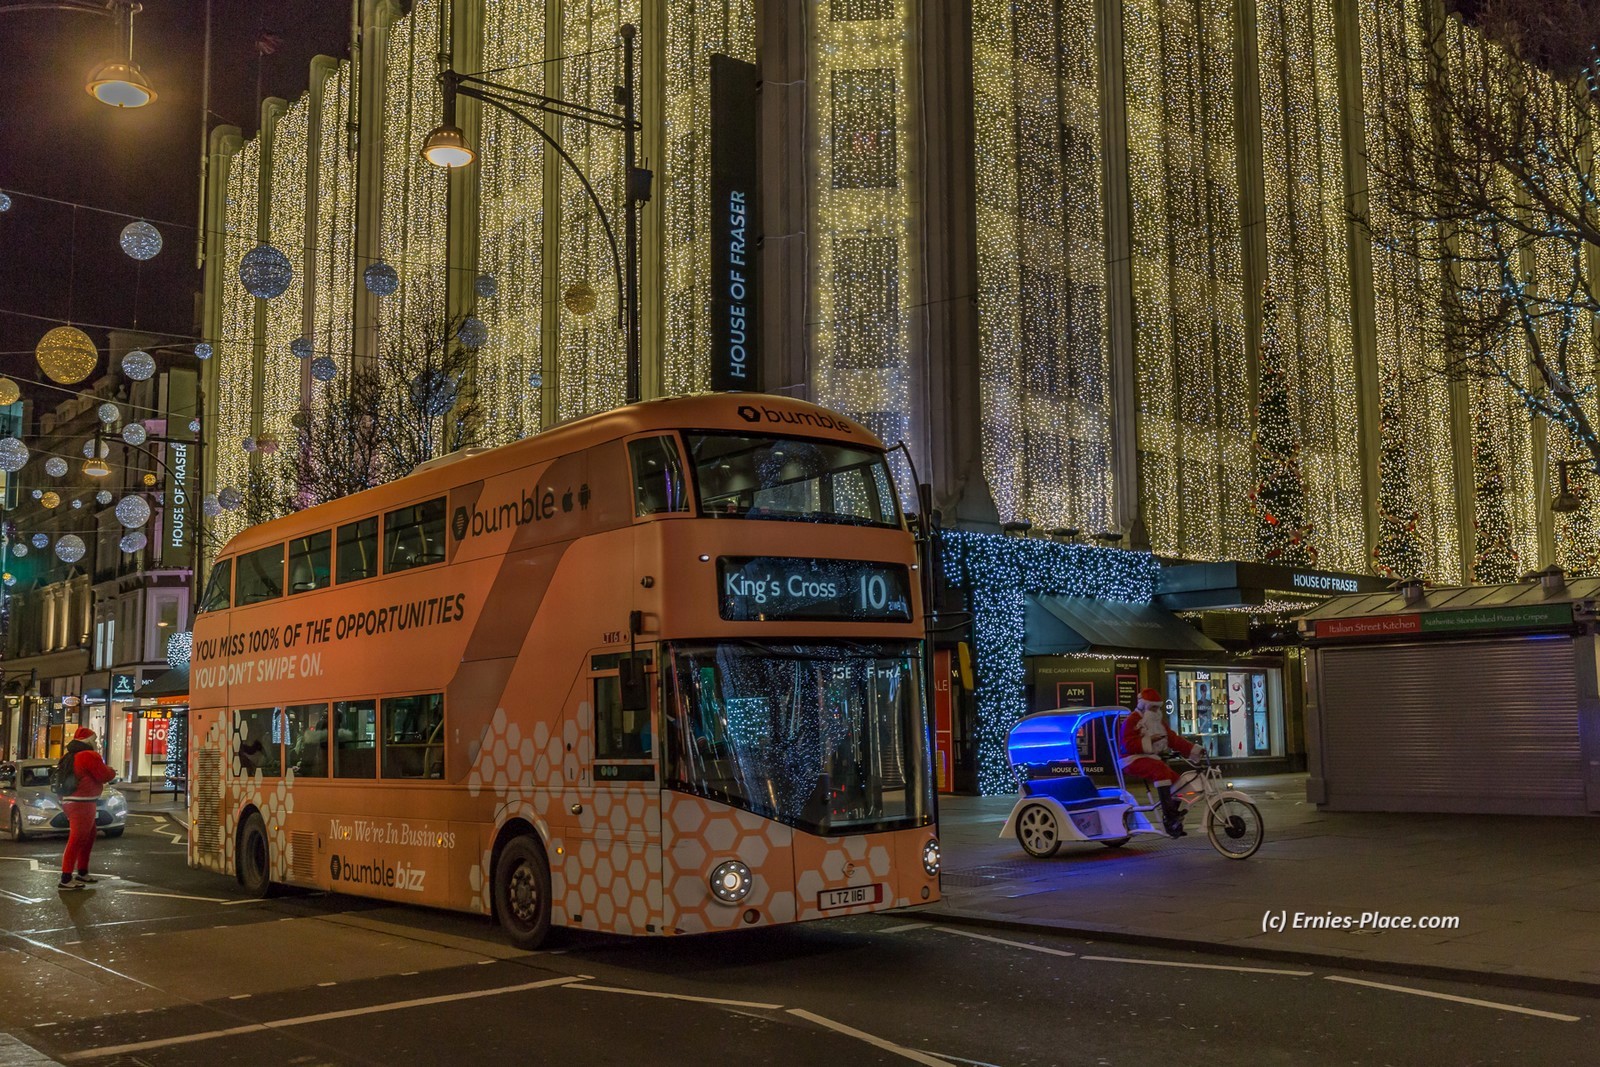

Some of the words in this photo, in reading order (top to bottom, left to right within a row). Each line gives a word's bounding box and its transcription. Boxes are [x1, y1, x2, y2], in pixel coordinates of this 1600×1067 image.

[730, 190, 746, 266] FRASER
[730, 270, 746, 300] OF
[730, 304, 746, 378] HOUSE
[761, 405, 853, 434] bumble
[175, 443, 187, 486] FRASER
[174, 487, 185, 505] OF
[471, 484, 556, 538] bumble
[172, 507, 184, 547] HOUSE
[725, 572, 781, 604] King's
[787, 574, 838, 598] Cross
[860, 574, 887, 610] 10
[1293, 573, 1320, 589] HOUSE
[1320, 576, 1331, 590] OF
[1331, 578, 1358, 593] FRASER
[195, 640, 217, 662] YOU
[218, 633, 245, 658] MISS
[248, 626, 280, 653] 100%
[283, 623, 303, 648] OF
[306, 618, 333, 645] THE
[335, 593, 466, 641] OPPORTUNITIES
[1328, 622, 1354, 634] Italian
[1354, 622, 1381, 632] Street
[1382, 618, 1416, 630] Kitchen
[1424, 617, 1455, 626] Authentic
[194, 667, 216, 690] YOU
[218, 661, 255, 687] DON'T
[256, 655, 297, 683] SWIPE
[300, 652, 324, 678] ON.
[1196, 671, 1210, 680] Dior
[1066, 688, 1085, 696] ATM
[148, 729, 168, 741] 50
[329, 819, 352, 841] Now
[354, 820, 384, 844] We're
[385, 822, 399, 844] In
[400, 823, 456, 849] Business
[830, 891, 850, 906] LTZ
[851, 888, 866, 902] 1161
